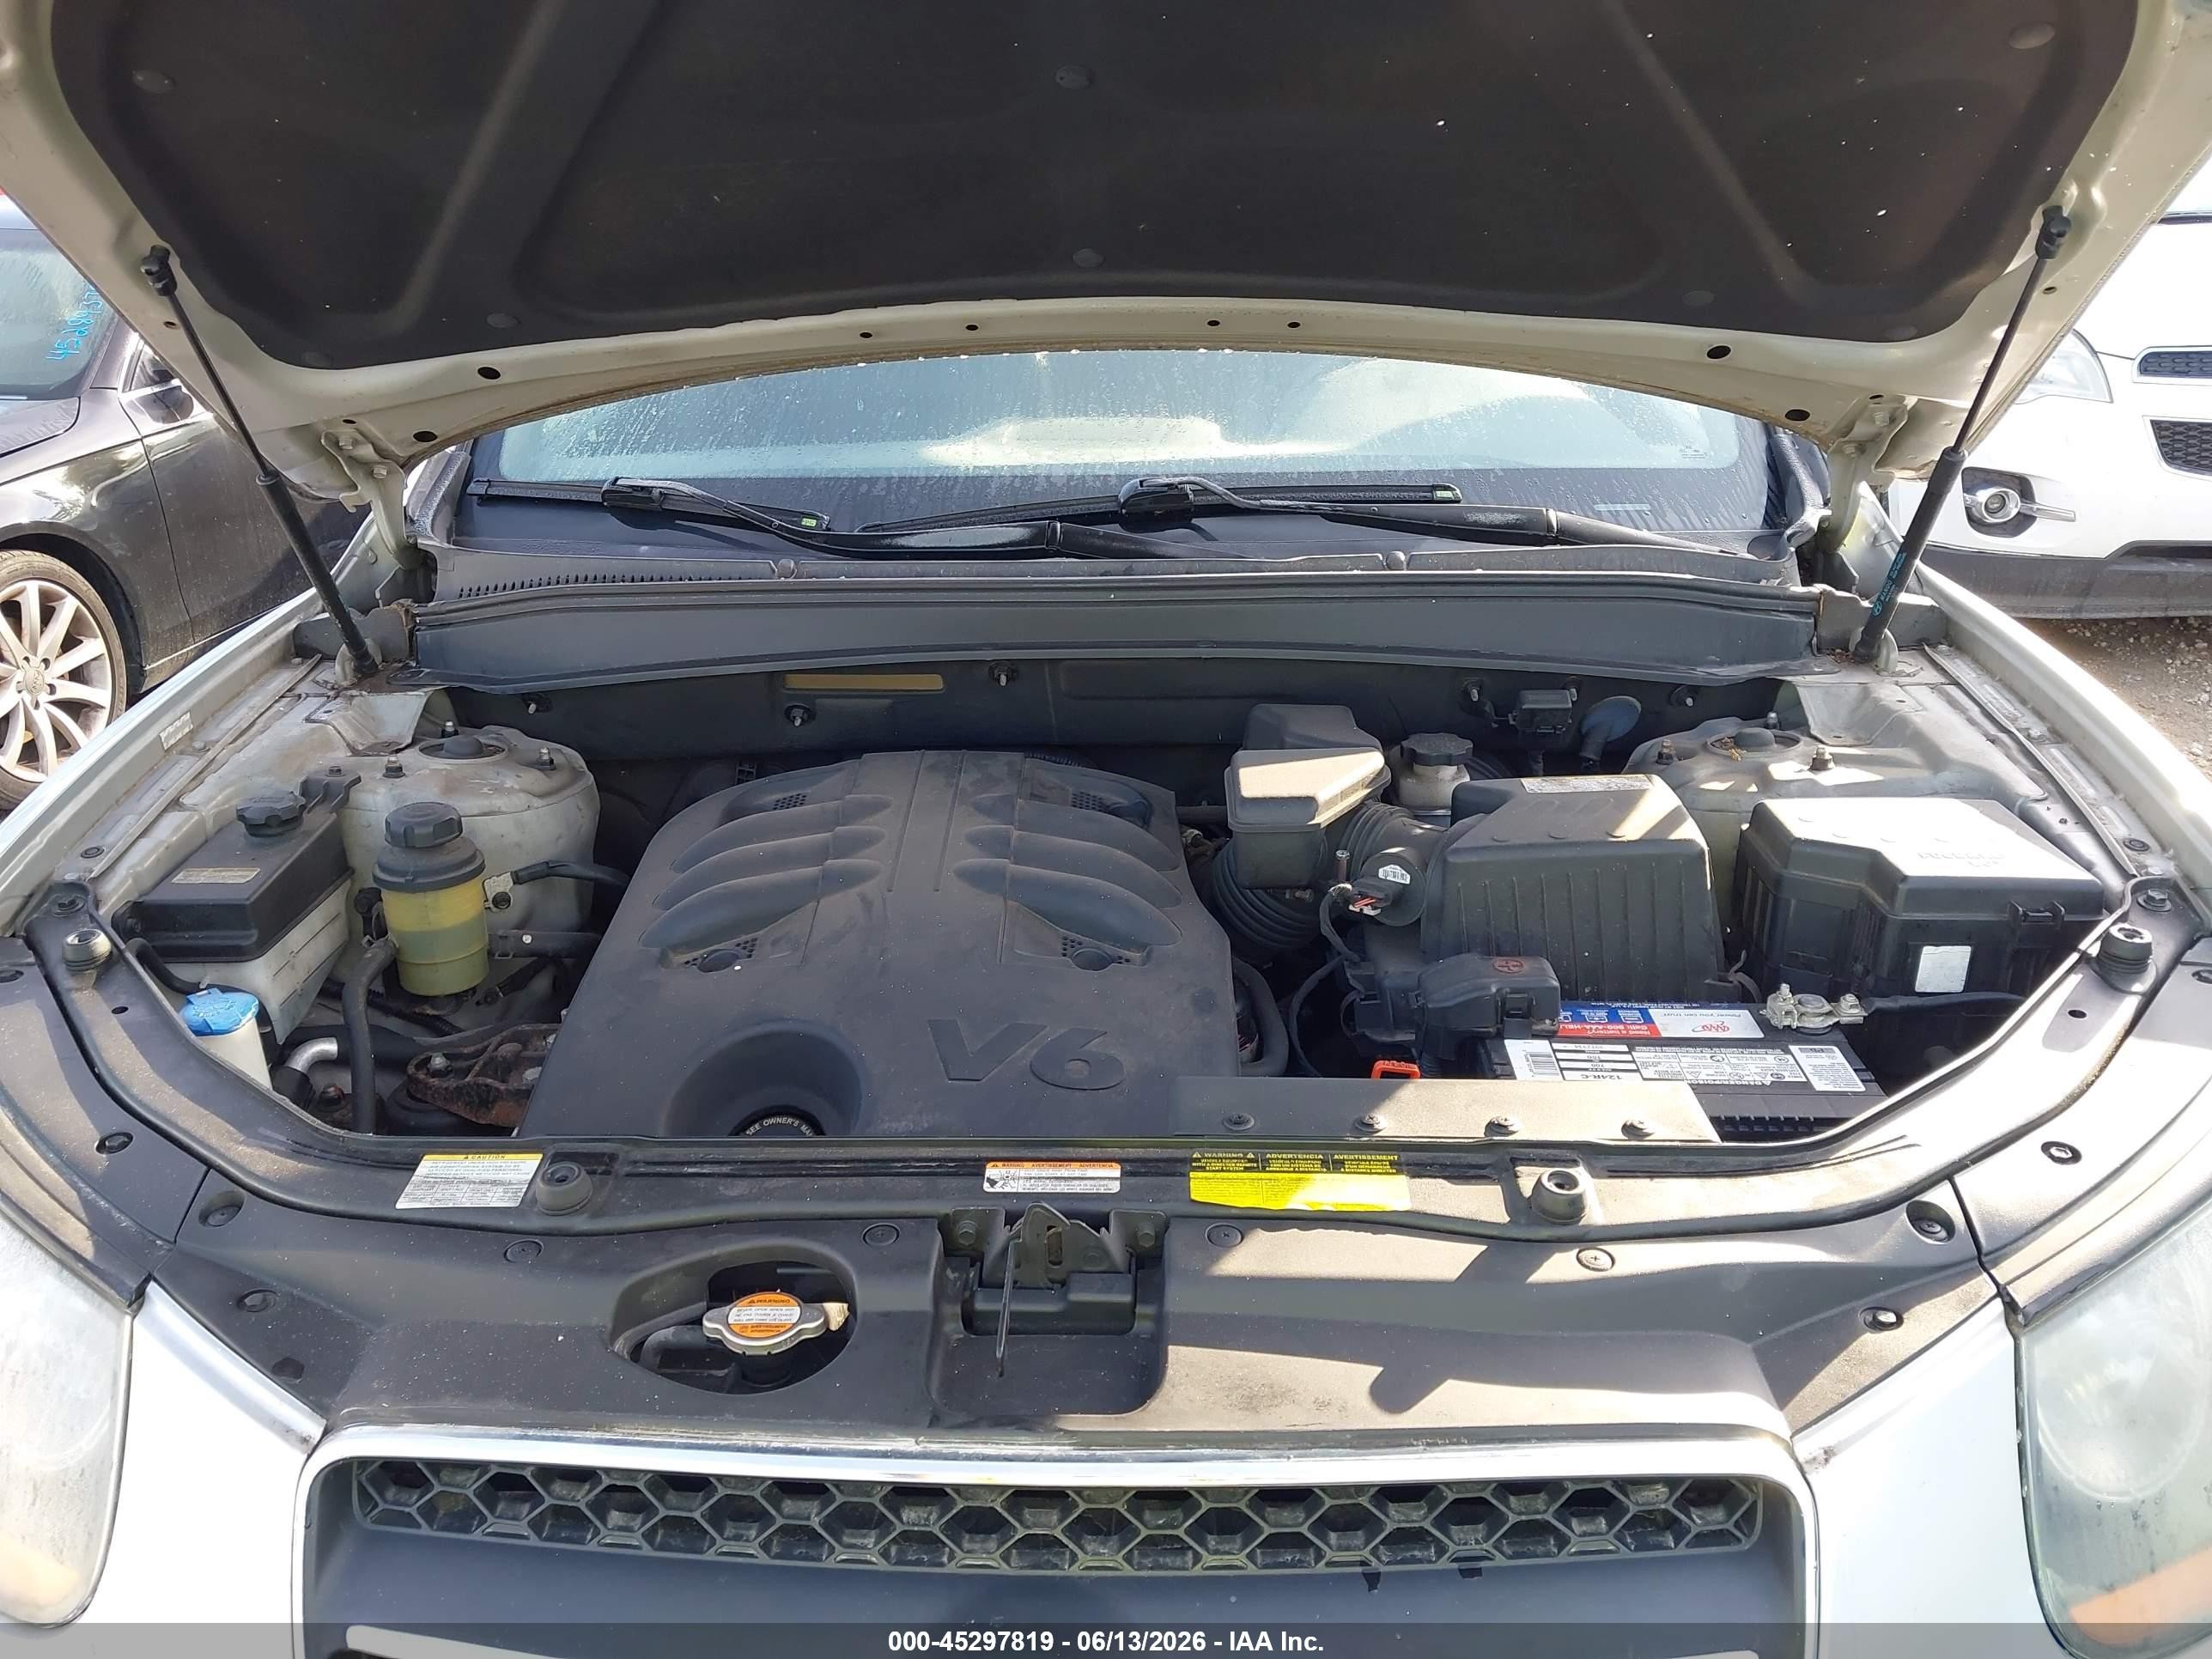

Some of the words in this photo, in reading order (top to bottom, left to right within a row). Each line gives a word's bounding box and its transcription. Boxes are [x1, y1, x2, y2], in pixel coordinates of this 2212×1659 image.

[927, 1019, 1126, 1091] V6
[745, 1122, 762, 1136] SEE
[763, 1117, 799, 1127] OWNER'S
